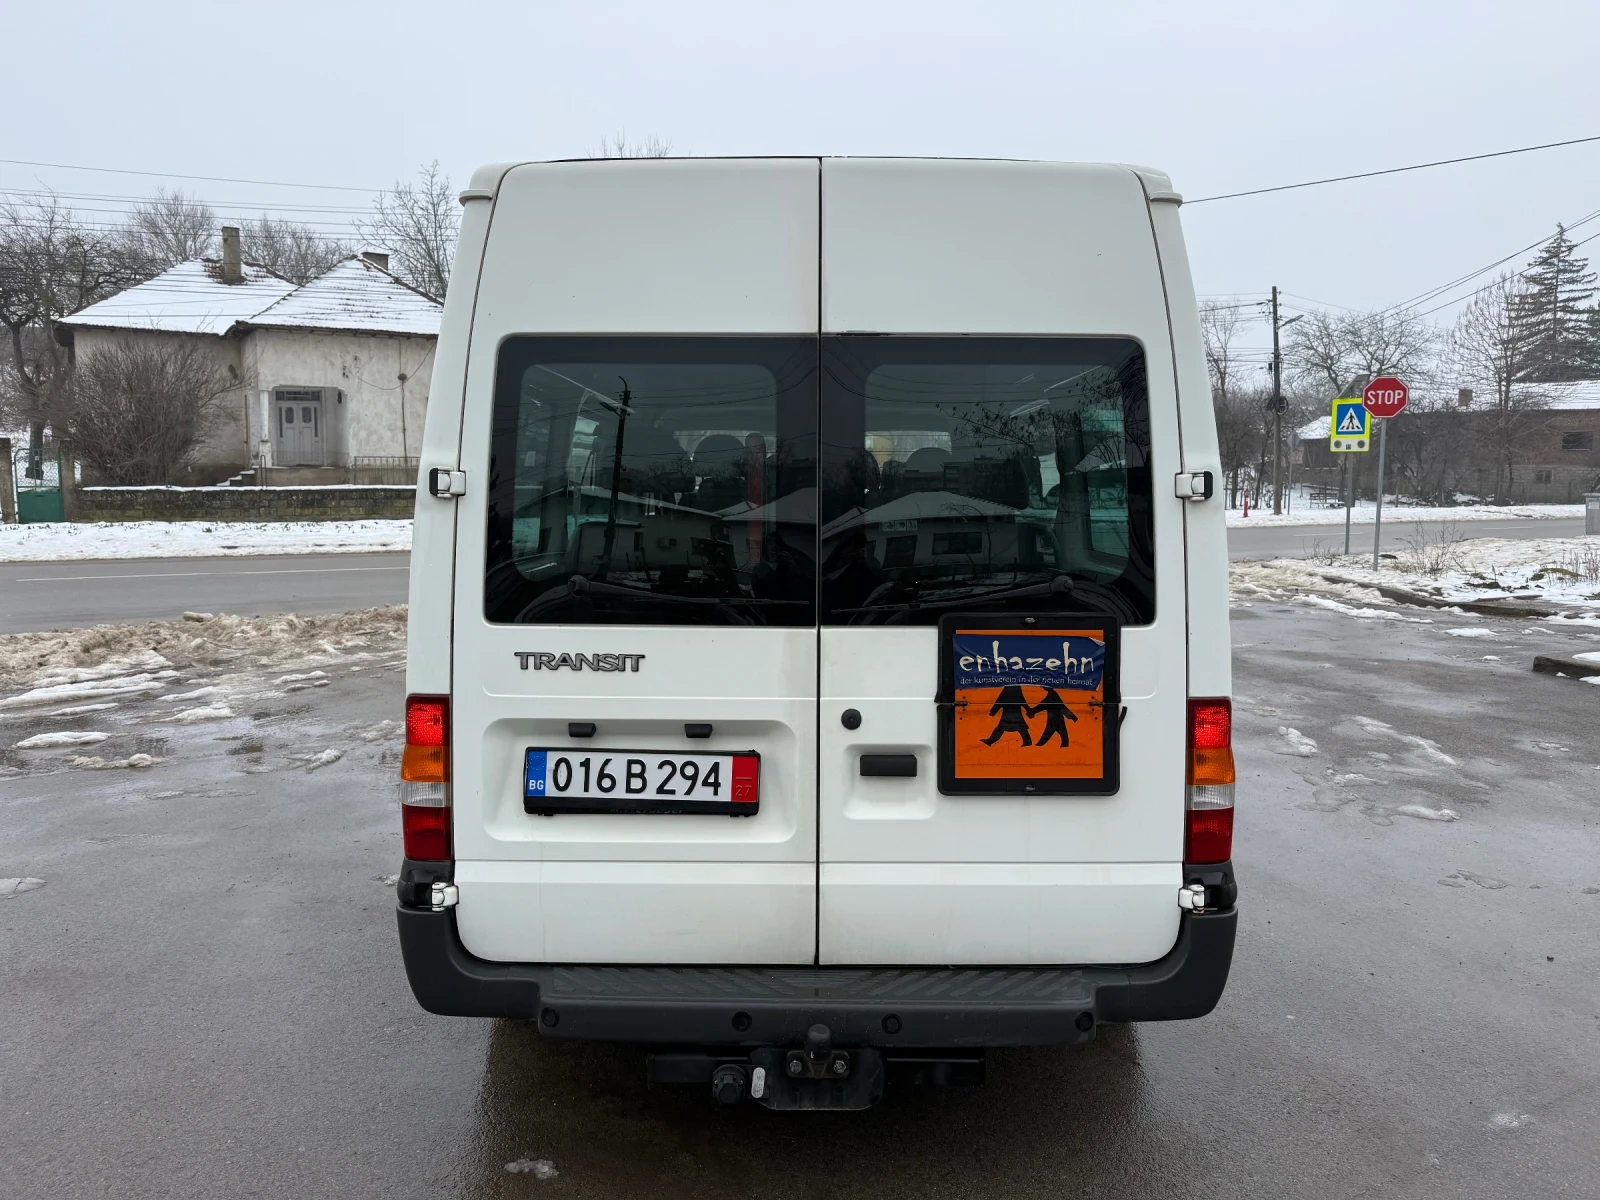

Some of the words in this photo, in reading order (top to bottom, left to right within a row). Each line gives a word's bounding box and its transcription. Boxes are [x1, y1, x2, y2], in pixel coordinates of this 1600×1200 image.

[1367, 390, 1404, 405] STOP
[514, 651, 645, 672] TRANSIT
[959, 640, 1094, 675] enhazehn
[960, 676, 973, 685] der
[974, 676, 1018, 685] kunstverein
[1019, 676, 1027, 684] in
[1028, 675, 1040, 684] der
[1042, 676, 1065, 685] neuen
[1067, 676, 1093, 686] heimat
[529, 780, 544, 790] BG
[735, 785, 752, 797] 27
